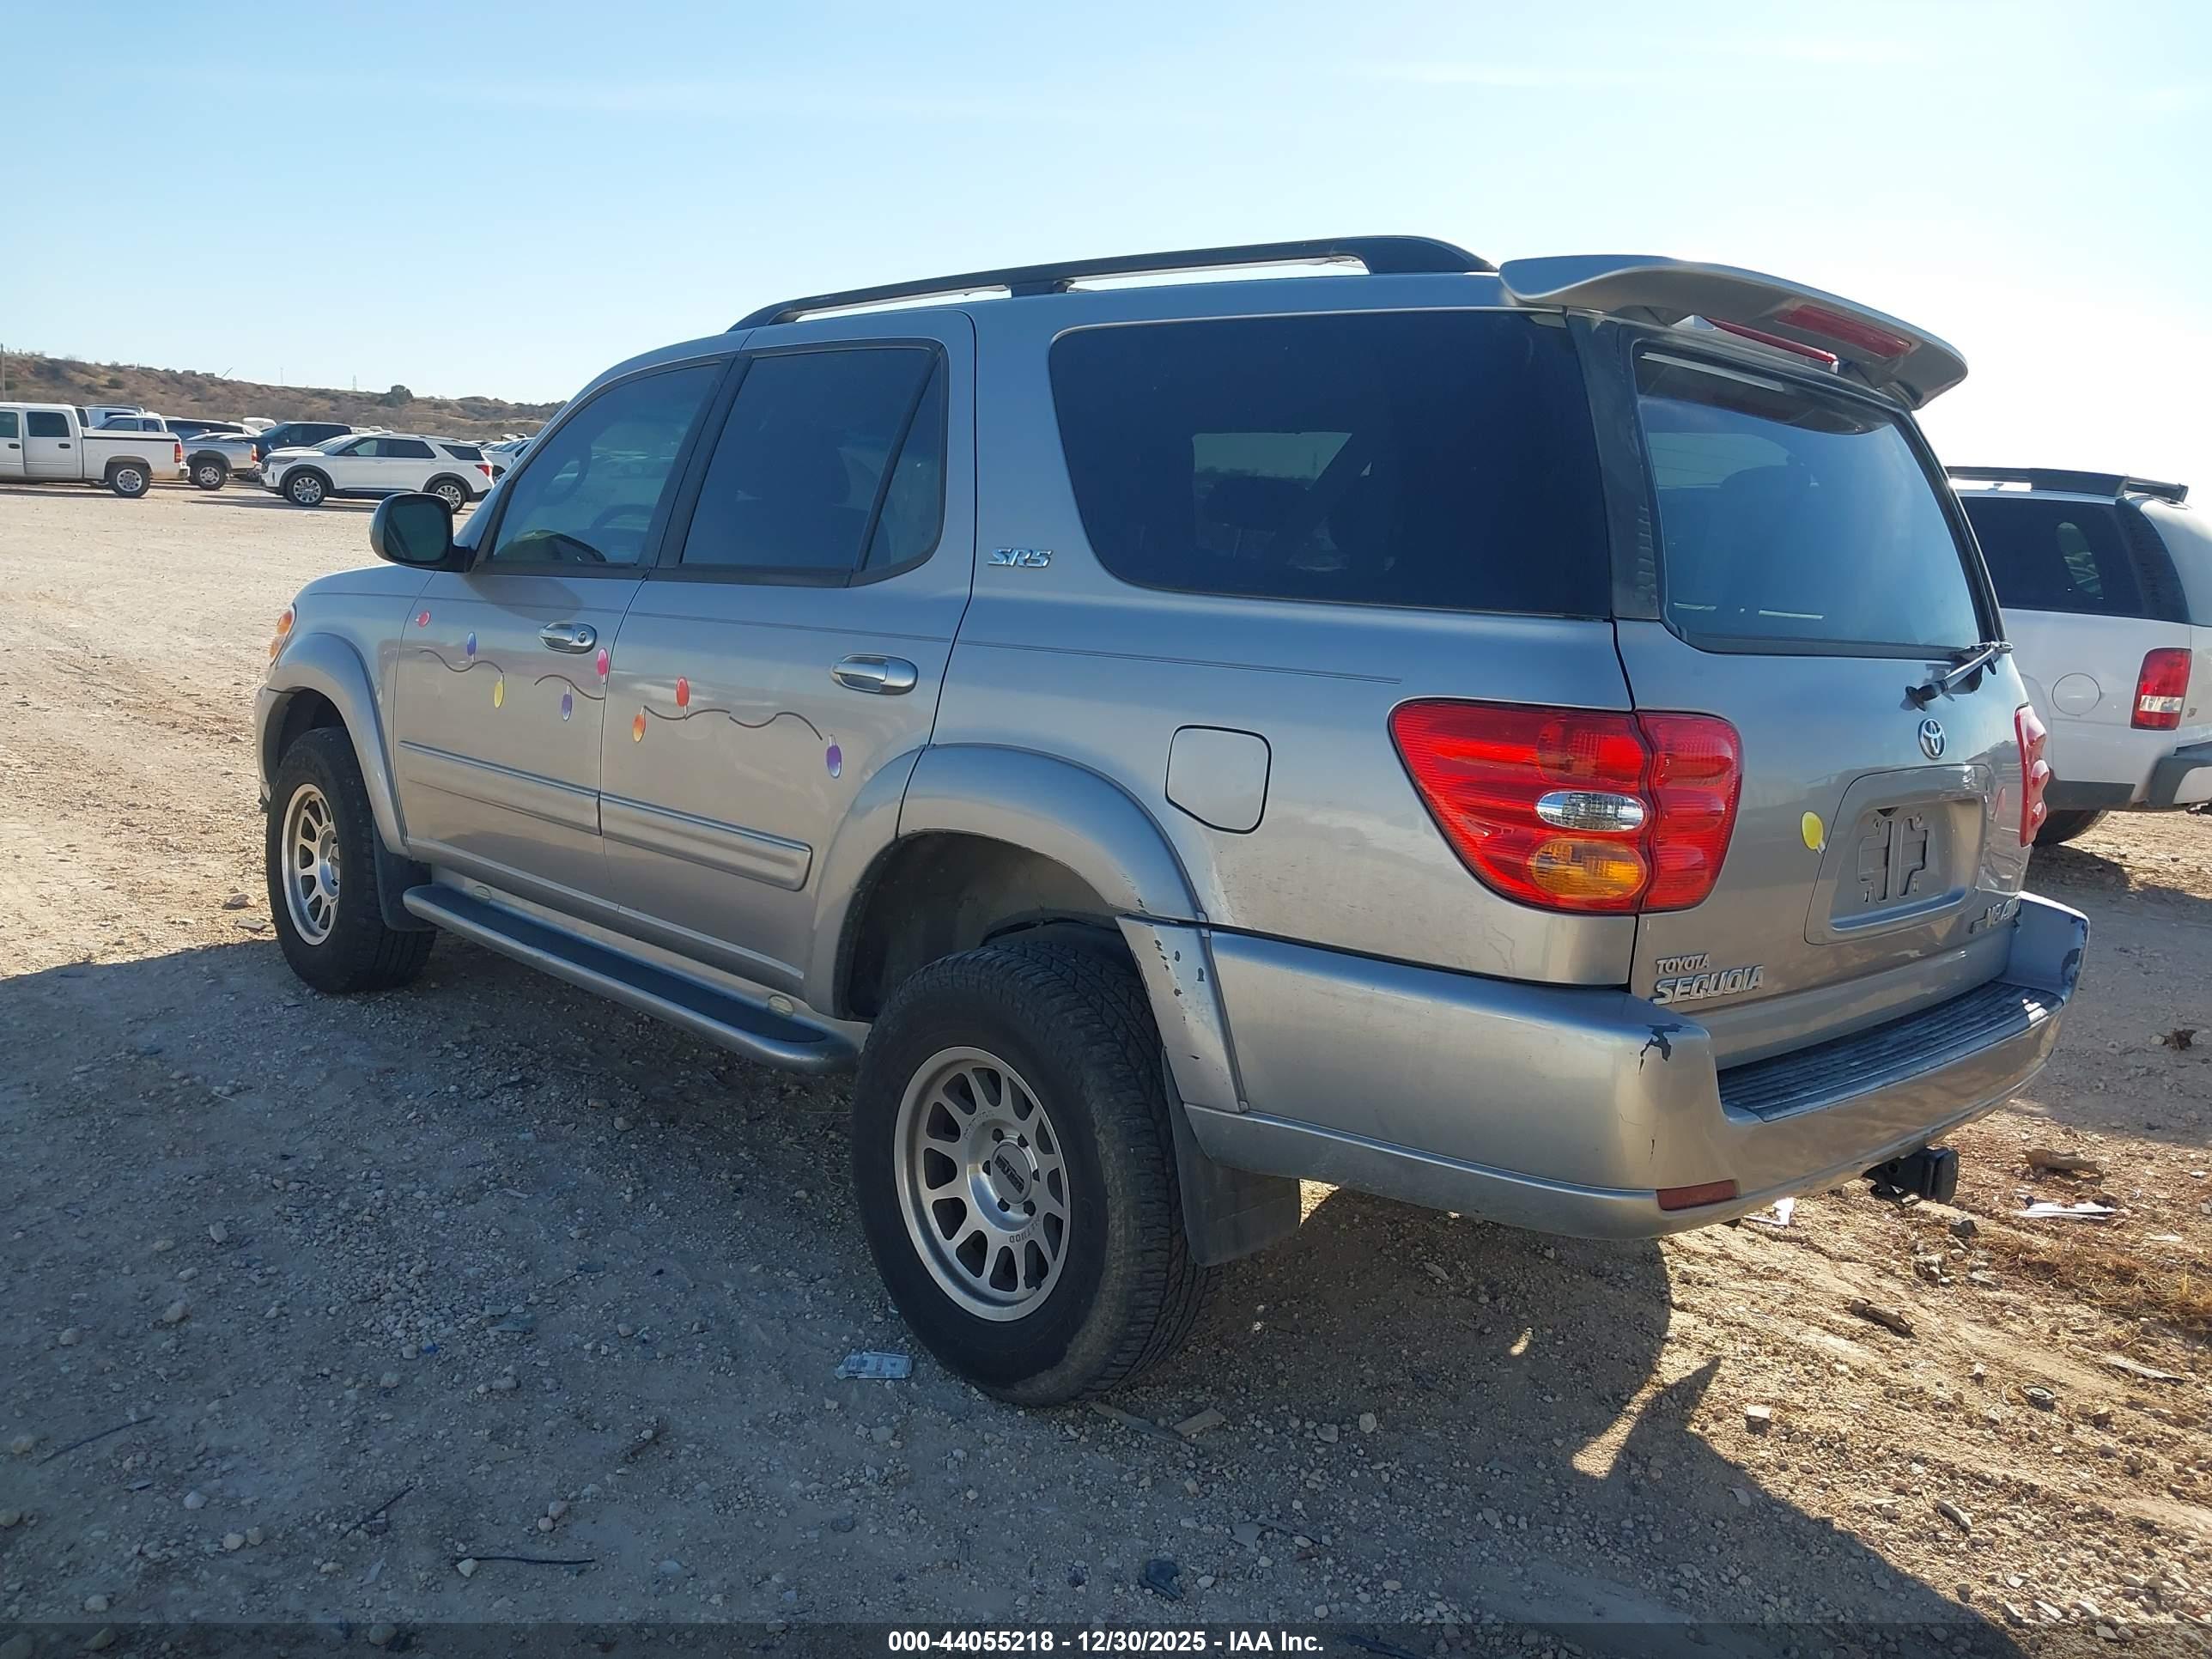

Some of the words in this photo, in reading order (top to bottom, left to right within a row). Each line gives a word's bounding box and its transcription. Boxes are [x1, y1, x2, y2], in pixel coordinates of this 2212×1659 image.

[988, 547, 1052, 568] SR5
[1656, 954, 1711, 975] TOYOTA
[1652, 965, 1765, 1005] SEQUOIA
